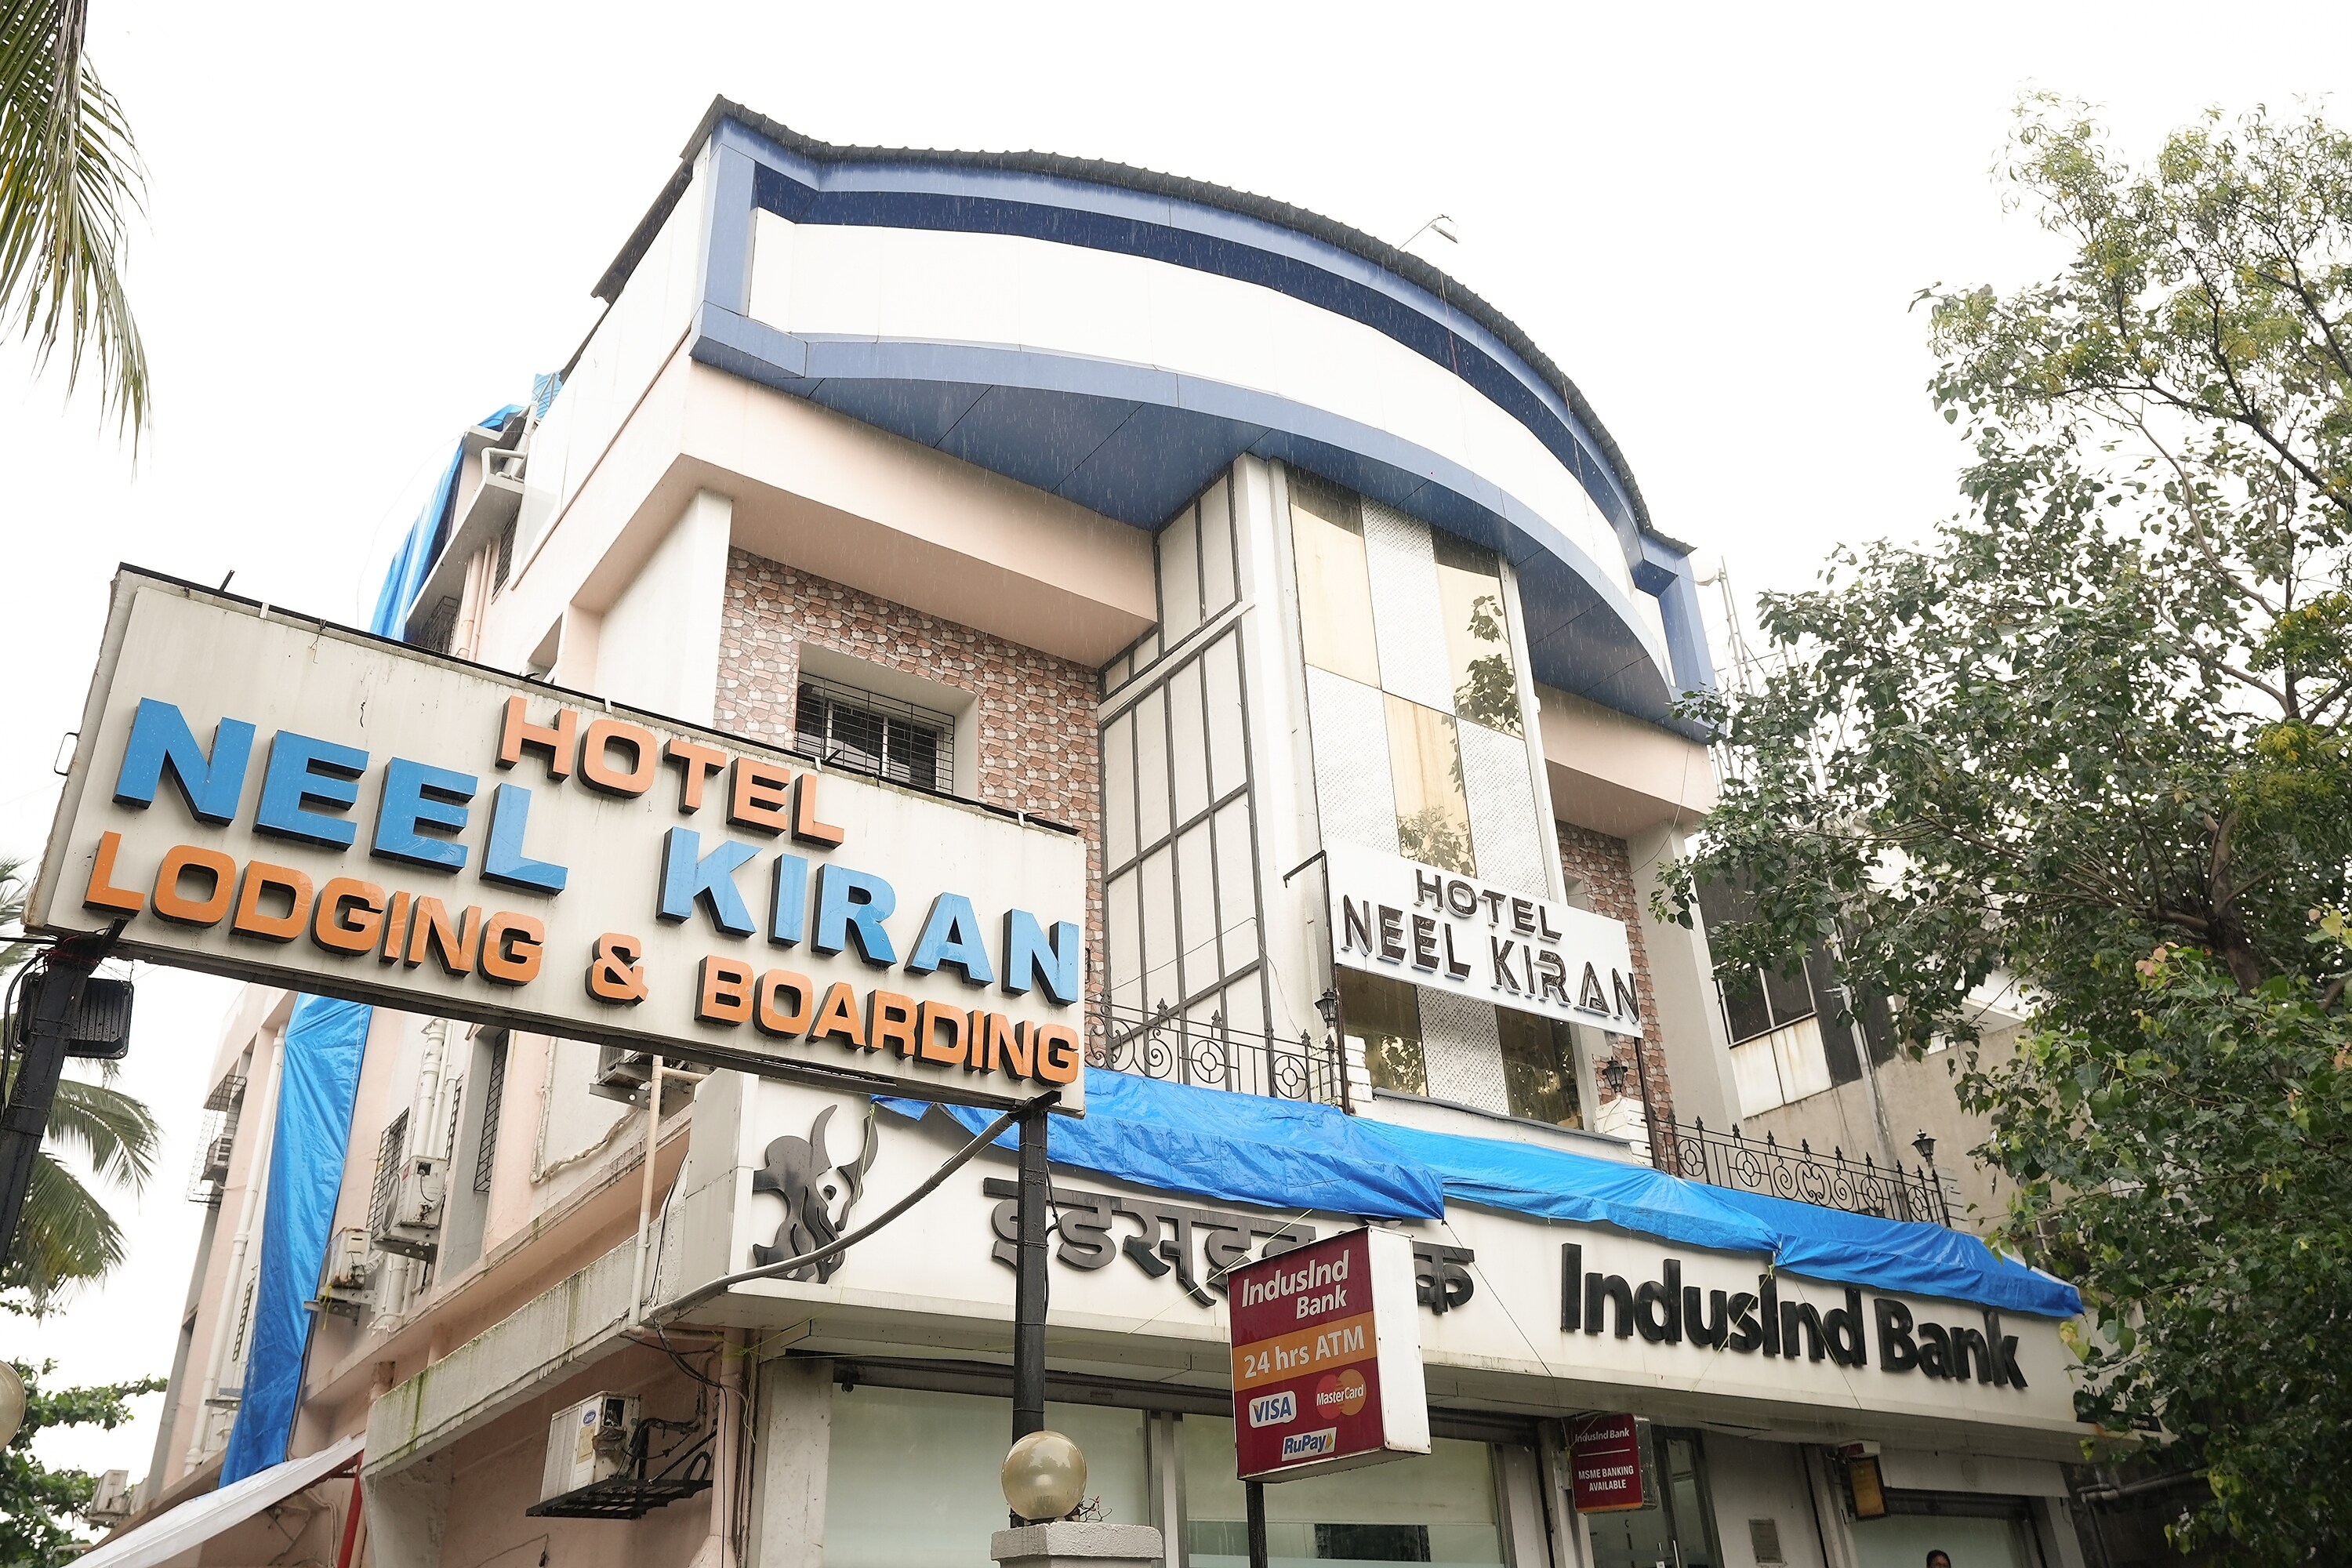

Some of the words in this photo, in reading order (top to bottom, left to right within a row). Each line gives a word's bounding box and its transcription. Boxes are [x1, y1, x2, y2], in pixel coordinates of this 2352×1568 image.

[495, 695, 844, 848] HOTEL
[112, 698, 568, 896] NEEL
[656, 826, 1079, 1005] KIRAN
[1414, 869, 1563, 942] HOTEL
[82, 830, 545, 987] LODGING
[585, 933, 648, 1006] &
[695, 955, 1080, 1086] BOARDING
[1338, 895, 1472, 981] NEEL
[1489, 935, 1639, 1024] KIRAN
[1242, 1250, 1349, 1307] IndusInd
[1296, 1284, 1347, 1319] Bank
[1561, 1243, 1867, 1368] IndusInd
[1874, 1298, 2028, 1389] Bank
[1243, 1351, 1270, 1378] 24
[1275, 1345, 1310, 1370] hrs
[1316, 1325, 1365, 1361] ATM
[1252, 1396, 1292, 1423] VISA
[1316, 1384, 1364, 1406] MasterCard
[1283, 1435, 1327, 1454] RuPay
[1574, 1430, 1609, 1443] IndusInd
[1610, 1428, 1630, 1439] Bank
[1578, 1468, 1601, 1480] MSME
[1602, 1465, 1634, 1478] BANKING
[1588, 1479, 1627, 1492] AVAILABLE
